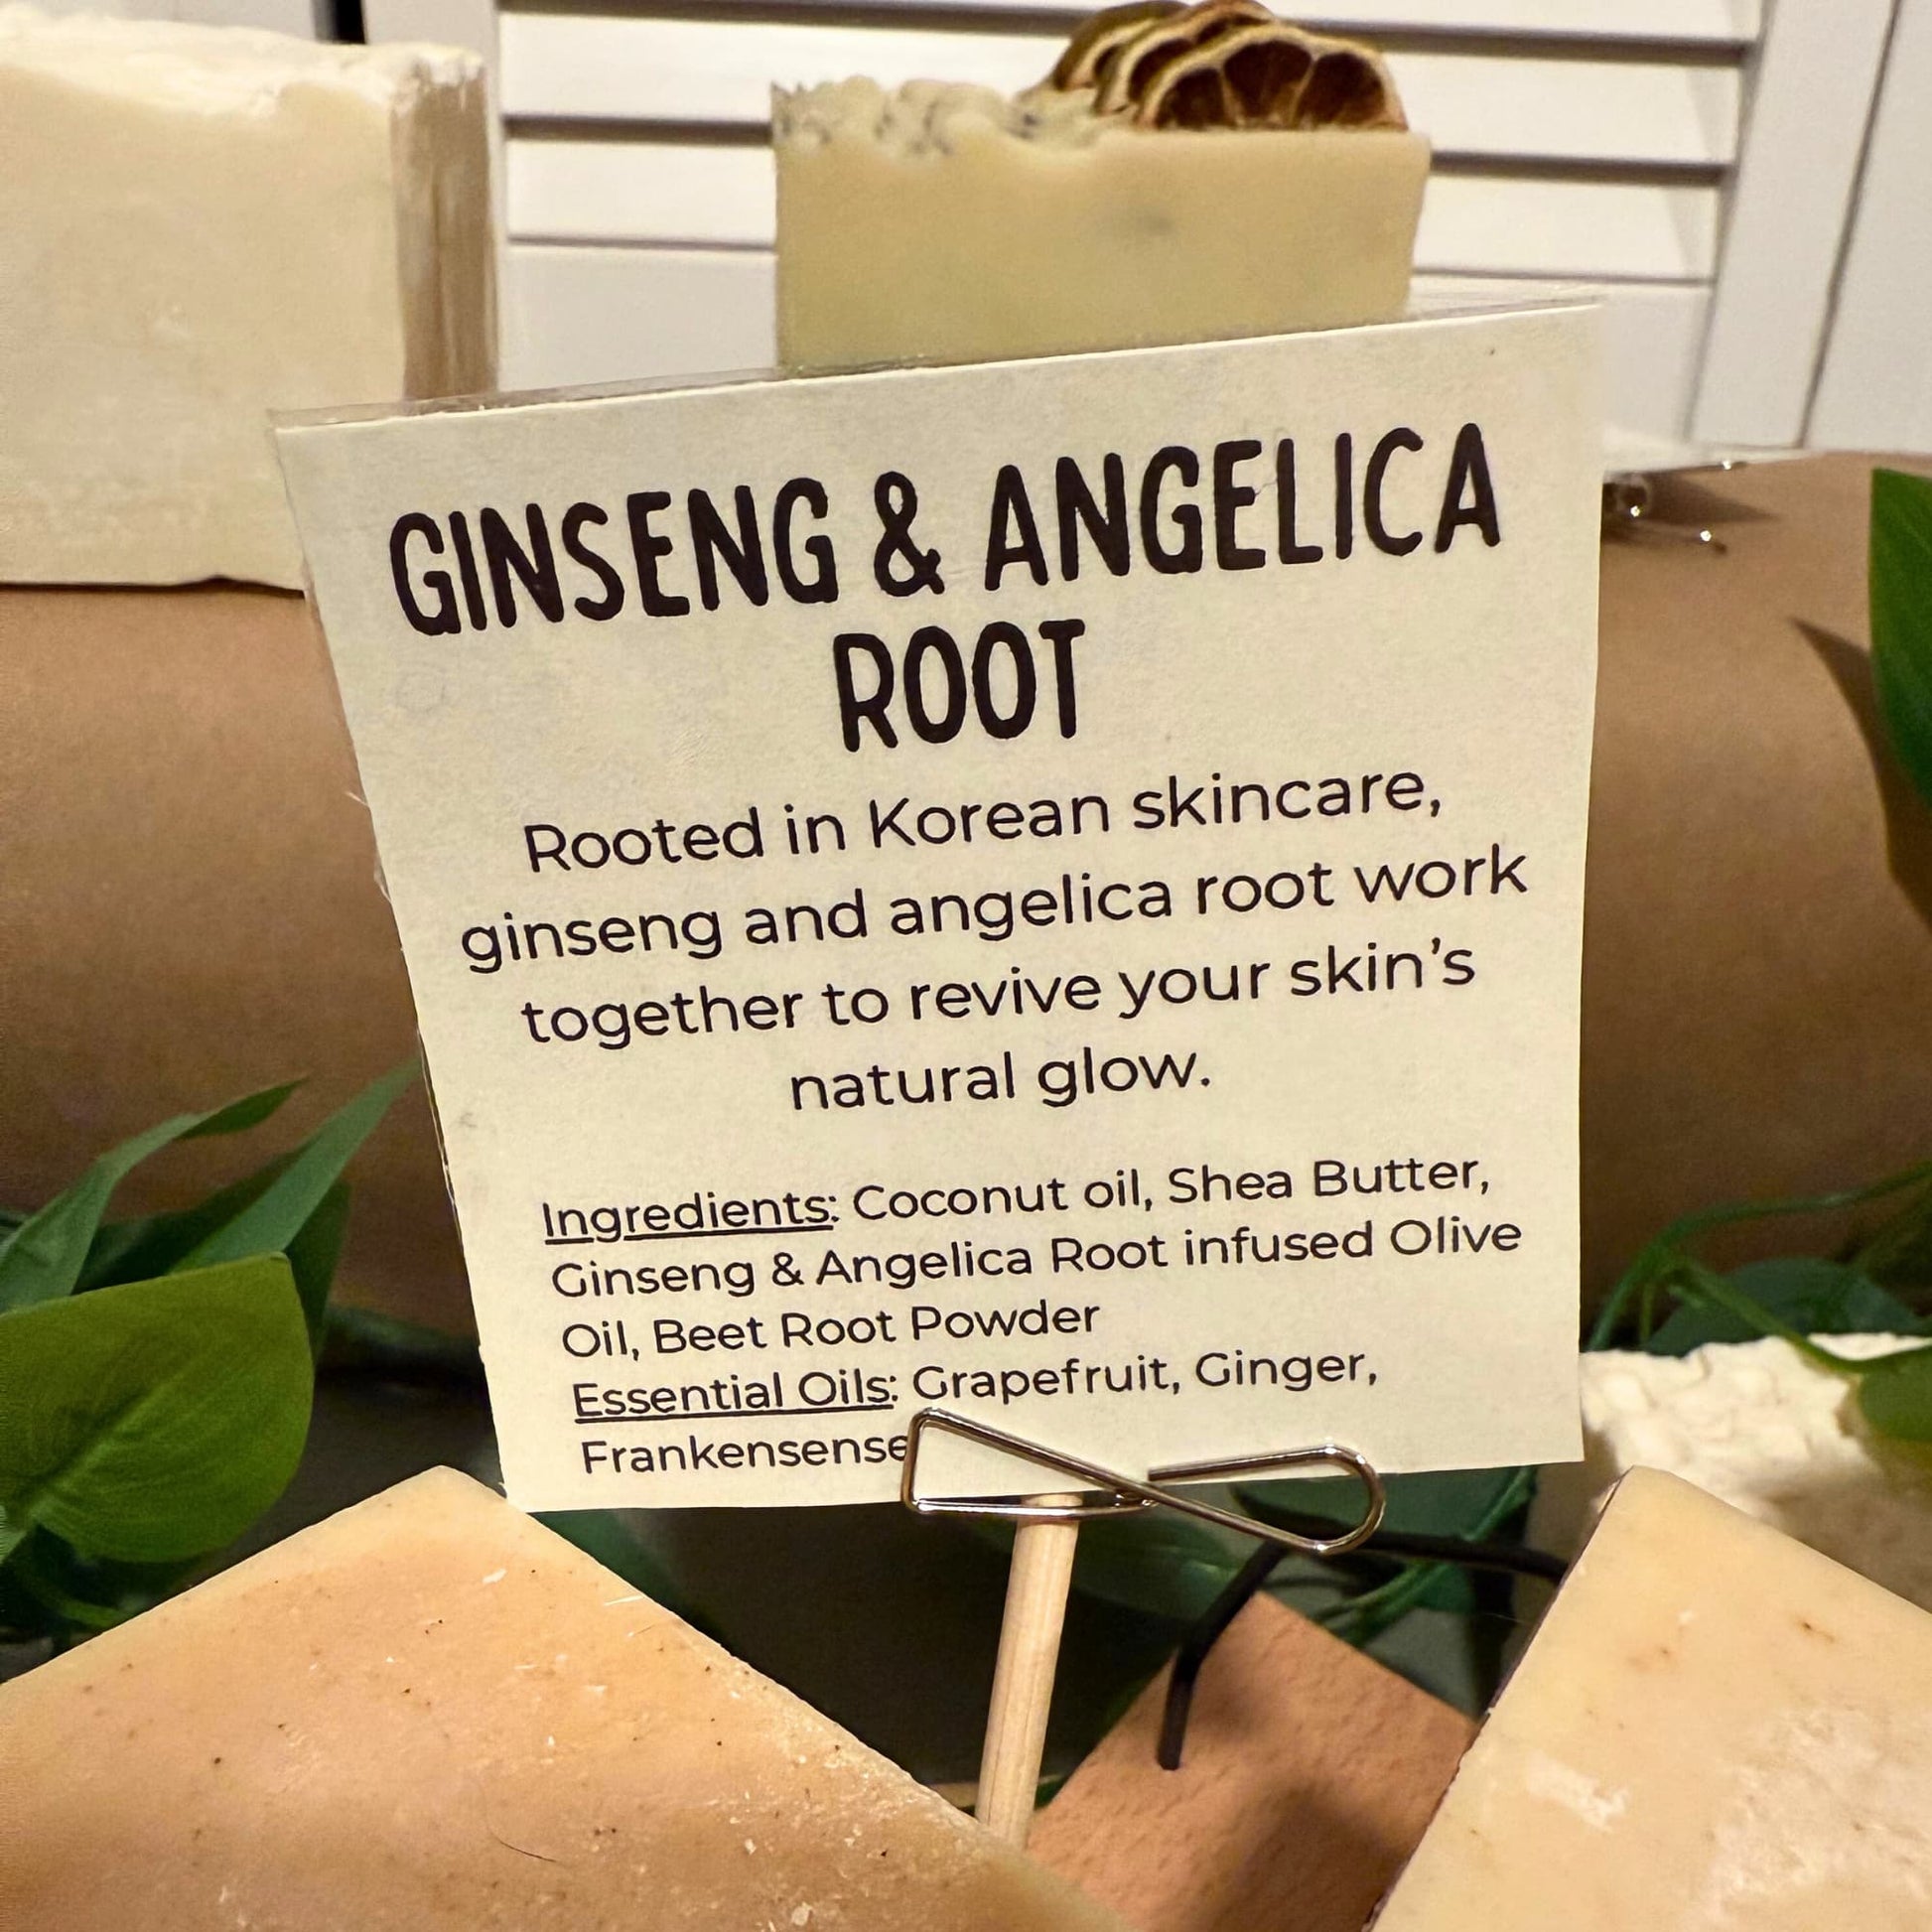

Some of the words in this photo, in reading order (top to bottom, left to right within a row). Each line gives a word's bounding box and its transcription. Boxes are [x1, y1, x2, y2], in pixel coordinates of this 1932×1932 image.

[388, 477, 840, 637] GINSENG
[873, 471, 946, 598] &
[984, 422, 1501, 592] ANGELICA
[832, 618, 1086, 754] ROOT
[523, 805, 764, 874] Rooted
[783, 803, 846, 855] in
[869, 795, 1110, 849] Korean
[1133, 771, 1441, 830] skincare,
[461, 910, 723, 975] ginseng
[745, 888, 868, 945] and
[890, 872, 1173, 942] angelica
[1196, 862, 1335, 915] root
[1353, 842, 1528, 903] work
[520, 985, 803, 1050] together
[820, 983, 890, 1027] to
[910, 966, 1102, 1021] revive
[1118, 962, 1271, 1020] your
[1290, 936, 1475, 997] skin’s
[790, 1050, 1016, 1111] natural
[1037, 1045, 1210, 1108] glow.
[542, 1191, 840, 1246] Ingredients:
[853, 1177, 1069, 1221] Coconut
[1083, 1168, 1153, 1212] oil,
[1168, 1164, 1293, 1204] Shea
[1313, 1158, 1489, 1197] Butter,
[551, 1260, 756, 1298] Ginseng
[771, 1251, 805, 1287] &
[815, 1240, 1033, 1290] Angelica
[1050, 1235, 1169, 1274] Root
[1184, 1219, 1373, 1266] infused
[1390, 1215, 1522, 1256] Olive
[562, 1319, 639, 1362] Oil,
[653, 1316, 768, 1354] Beet
[780, 1311, 897, 1348] Root
[910, 1299, 1101, 1341] Powder
[572, 1371, 784, 1425] Essential
[797, 1366, 899, 1412] Oils:
[912, 1354, 1180, 1406] Grapefruit,
[1195, 1349, 1377, 1392] Ginger,
